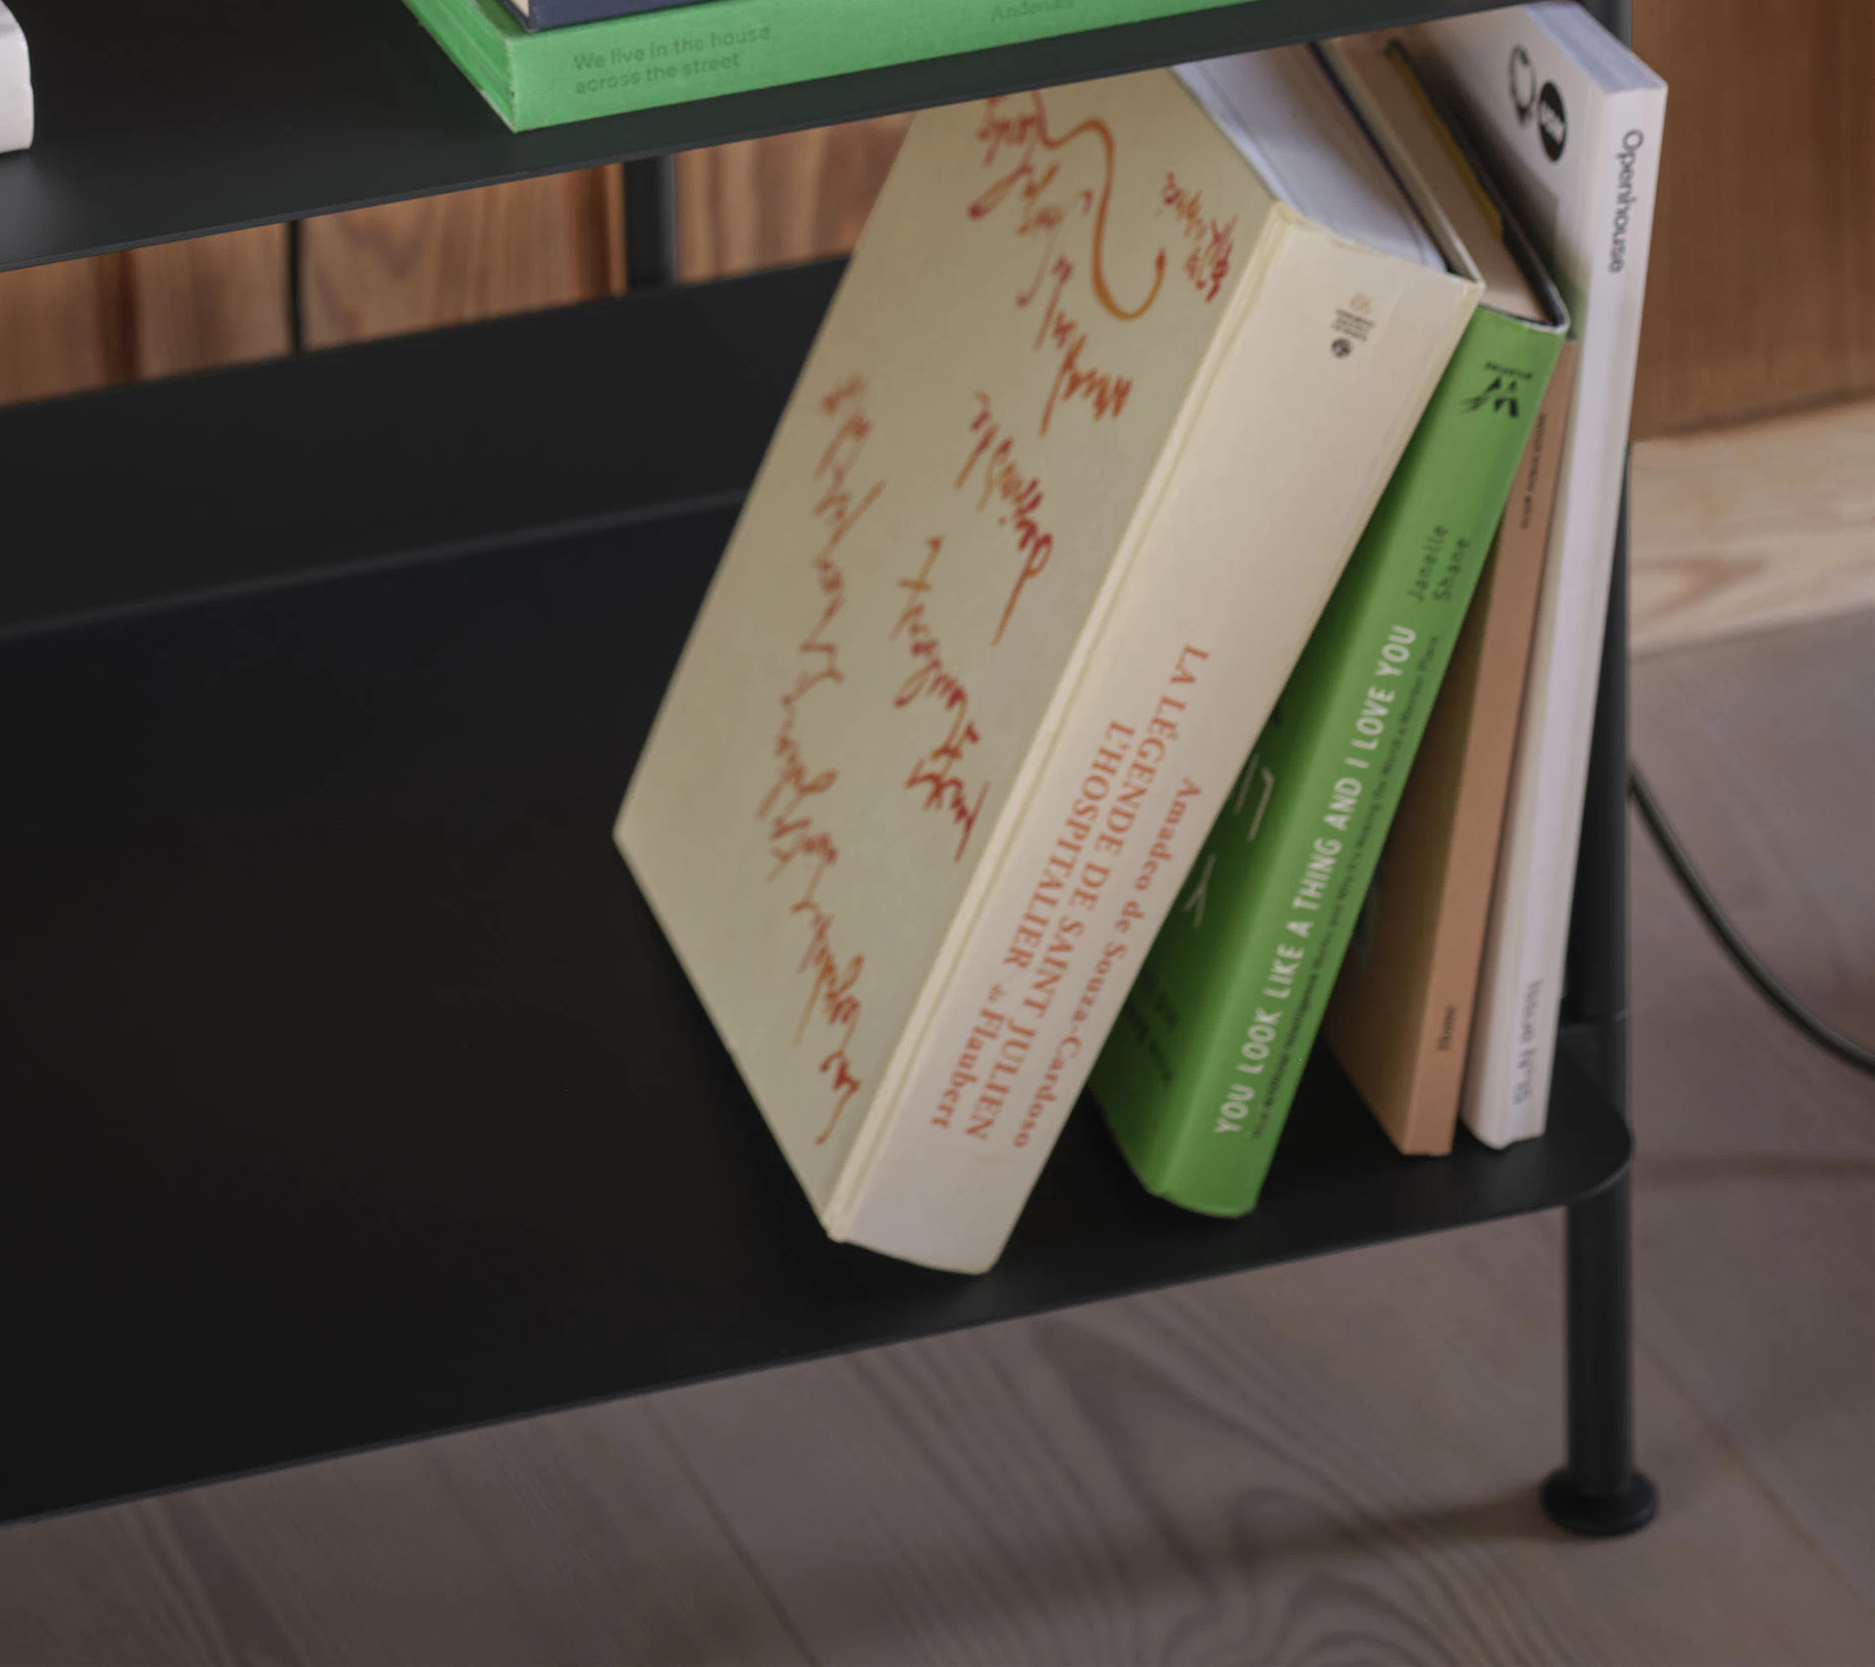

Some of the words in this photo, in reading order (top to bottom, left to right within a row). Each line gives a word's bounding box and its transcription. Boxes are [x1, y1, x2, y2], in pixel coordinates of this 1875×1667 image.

[573, 52, 607, 72] We
[611, 46, 645, 66] live
[650, 42, 669, 59] in
[674, 37, 705, 55] the
[710, 26, 771, 48] house
[576, 71, 642, 95] across
[645, 65, 678, 83] the
[680, 52, 741, 77] street
[1608, 128, 1645, 275] Openhouse
[1409, 522, 1450, 605] Janelle
[1434, 536, 1472, 602] Shane
[1169, 643, 1210, 688] LA
[1375, 624, 1418, 683] YOU
[1351, 681, 1396, 756] LOVE
[1093, 694, 1188, 857] LÉGENDE
[1323, 775, 1364, 833] AND
[1134, 777, 1202, 892] Amadeo
[1069, 859, 1112, 912] DE
[1291, 836, 1343, 913] THING
[1116, 898, 1147, 934] de
[1288, 913, 1314, 939] A
[1022, 915, 1086, 1019] SAINT
[1264, 942, 1306, 1002] LIKE
[930, 1003, 1006, 1131] Flaubert
[1011, 941, 1128, 1151] Souza-Cardoso
[1237, 1006, 1284, 1076] LOOK
[963, 1016, 1037, 1143] JULIEN
[1212, 1084, 1256, 1138] YOU
